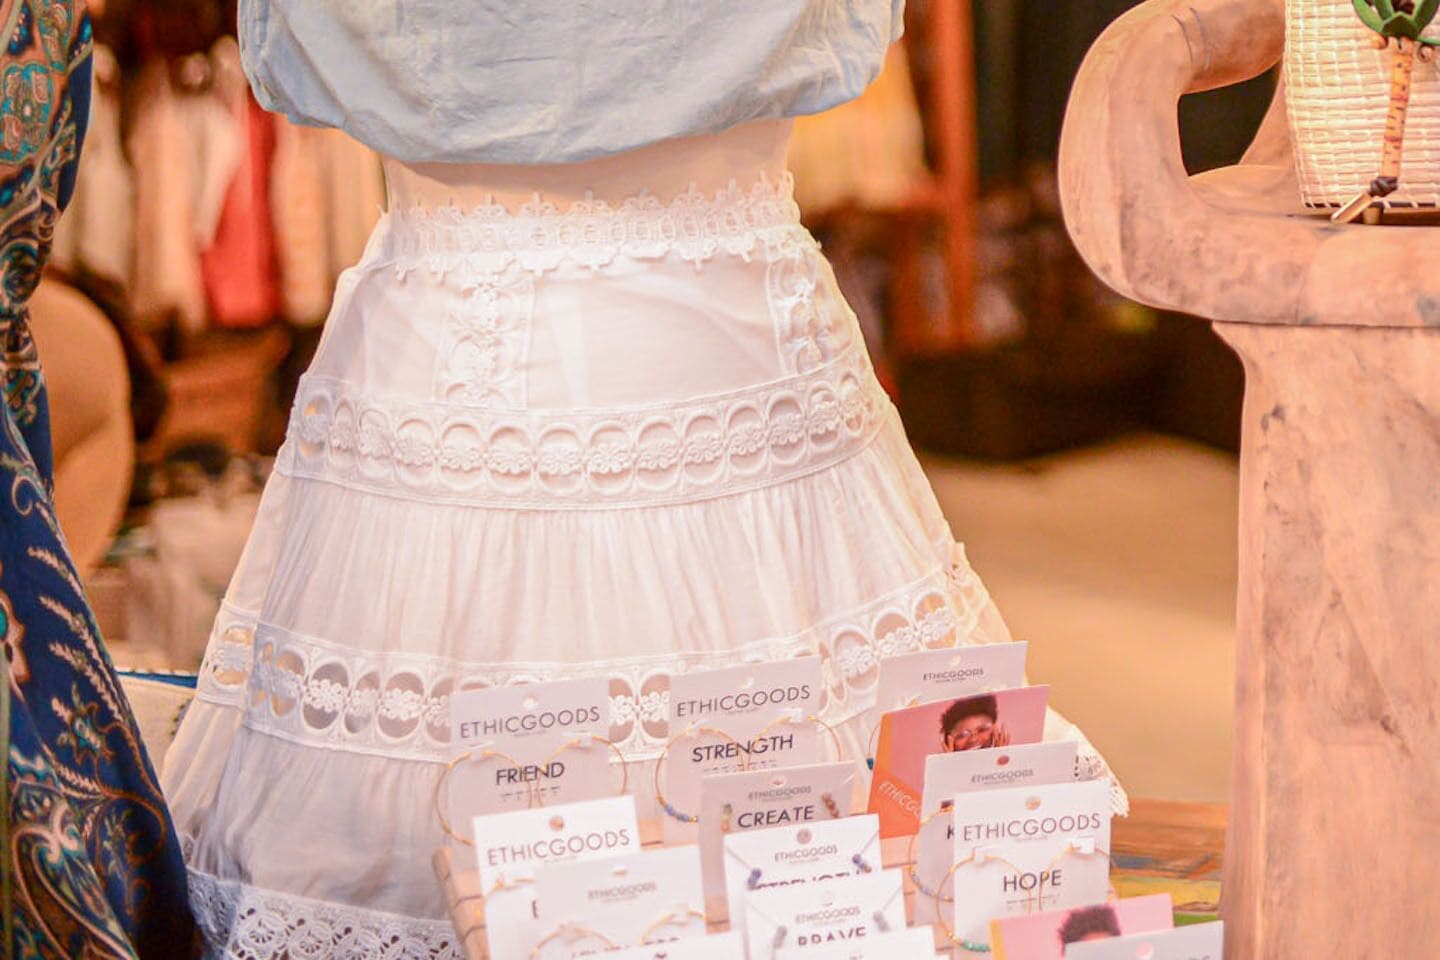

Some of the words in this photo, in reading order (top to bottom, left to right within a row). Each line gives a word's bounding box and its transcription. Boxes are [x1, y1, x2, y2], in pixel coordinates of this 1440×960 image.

[922, 667, 985, 681] ETHICGOODS
[677, 685, 811, 717] ETHICGOODS
[460, 706, 600, 739] ETHICGOODS
[692, 733, 794, 763] STRENGTH
[495, 762, 565, 786] FRIEND
[971, 769, 1035, 783] ETHICGOODS
[738, 805, 815, 828] CREATE
[963, 813, 1102, 841] ETHICGOODS
[487, 828, 631, 866] ETHICGOODS
[774, 844, 839, 862] ETHICGOODS
[1003, 869, 1063, 892] HOPE
